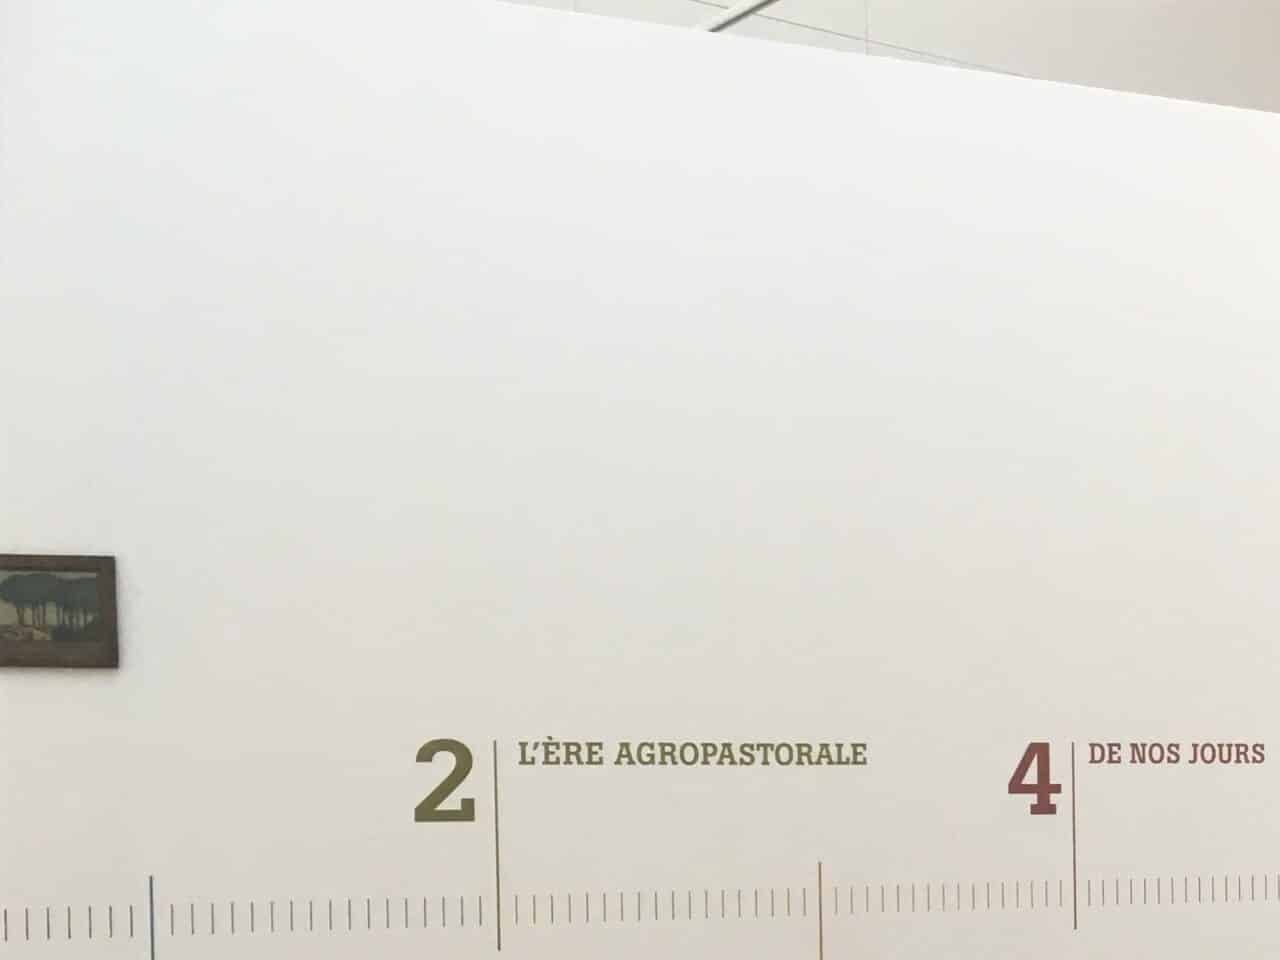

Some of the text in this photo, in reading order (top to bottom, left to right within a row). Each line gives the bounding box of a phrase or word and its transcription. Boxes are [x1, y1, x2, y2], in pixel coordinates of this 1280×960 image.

[517, 735, 868, 767] L'ÈRE AGROPASTORALE
[1087, 742, 1266, 765] DE NOS JOURS
[413, 738, 476, 823] 2
[1007, 741, 1063, 816] 4
